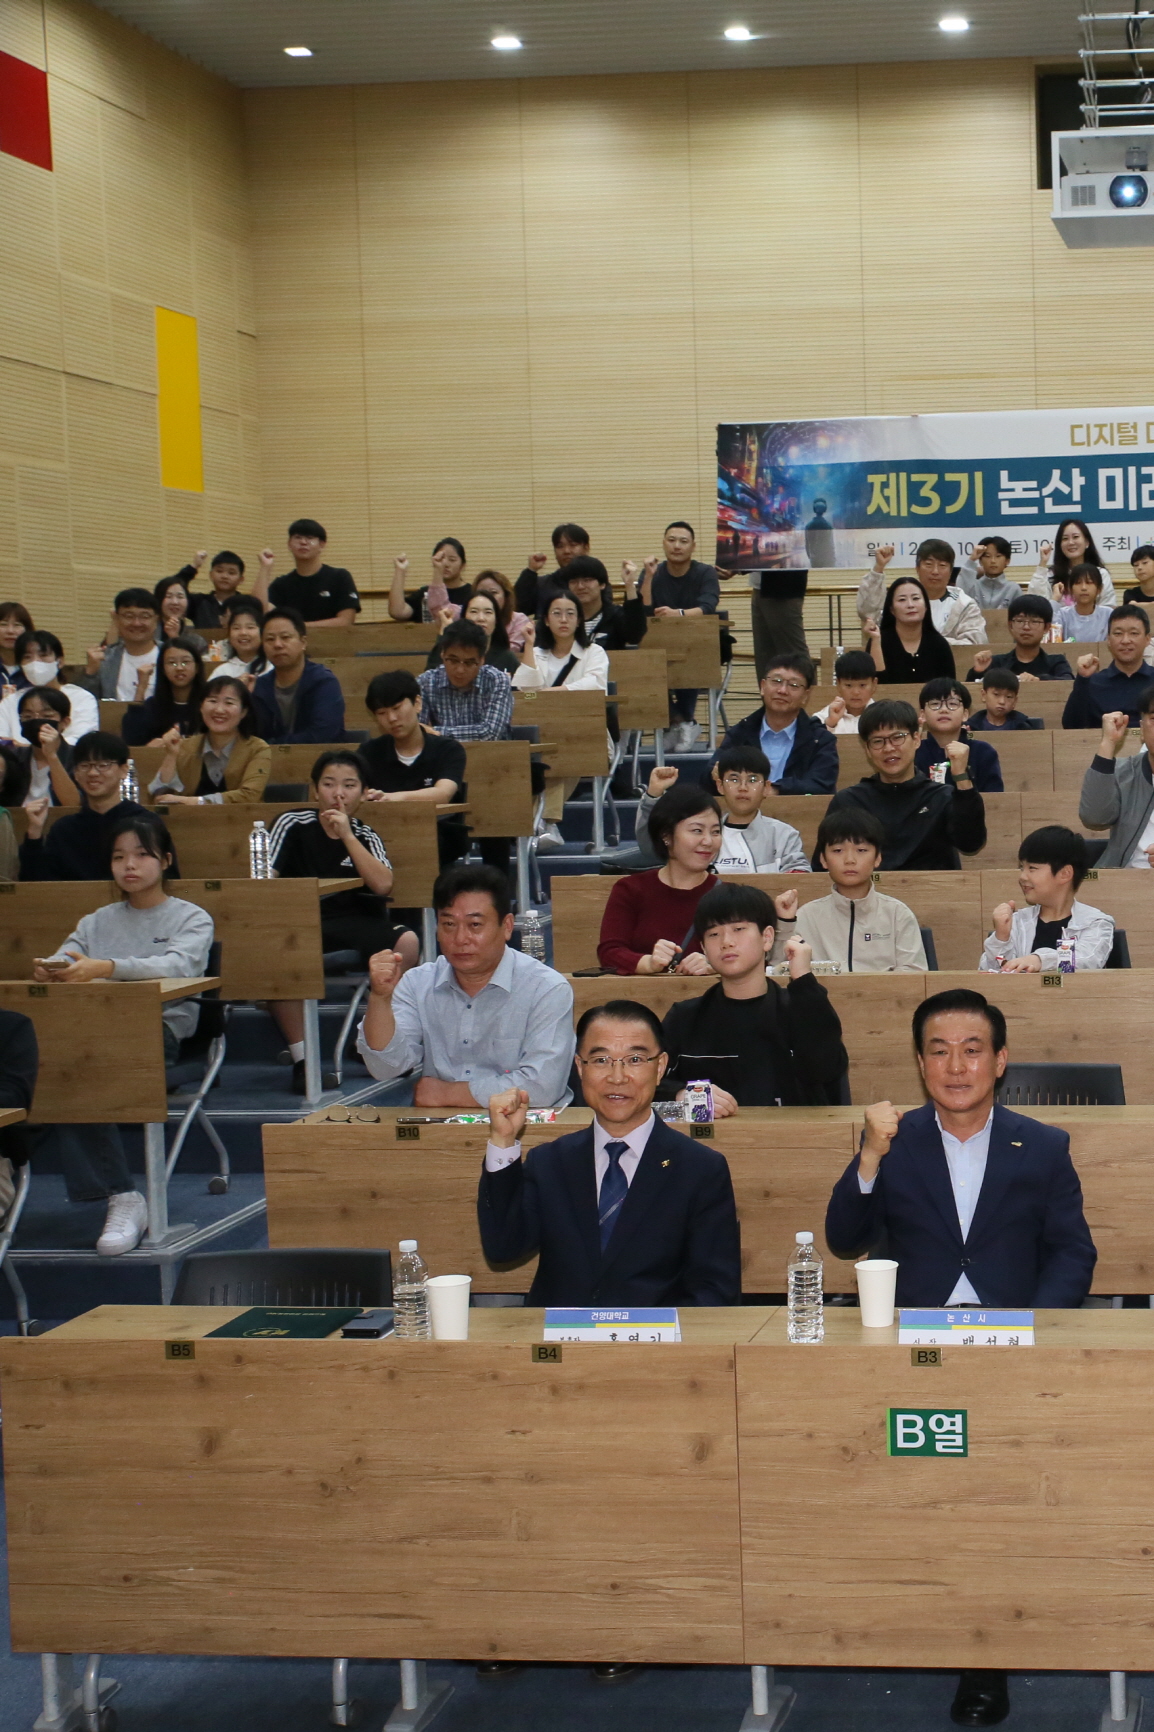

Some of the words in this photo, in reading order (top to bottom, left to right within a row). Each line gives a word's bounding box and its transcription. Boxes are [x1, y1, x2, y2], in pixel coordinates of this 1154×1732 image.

[1070, 421, 1138, 447] 디지털
[866, 471, 984, 517] 제3기
[998, 467, 1086, 515] 논산
[1102, 536, 1131, 552] 주최
[1043, 976, 1061, 985] B13
[398, 1128, 419, 1138] B10
[695, 1126, 711, 1137] B9
[591, 1311, 630, 1320] 건양대학교
[171, 1344, 191, 1357] B5
[538, 1347, 558, 1360] B4
[917, 1351, 938, 1363] B3
[895, 1413, 964, 1453] B열
